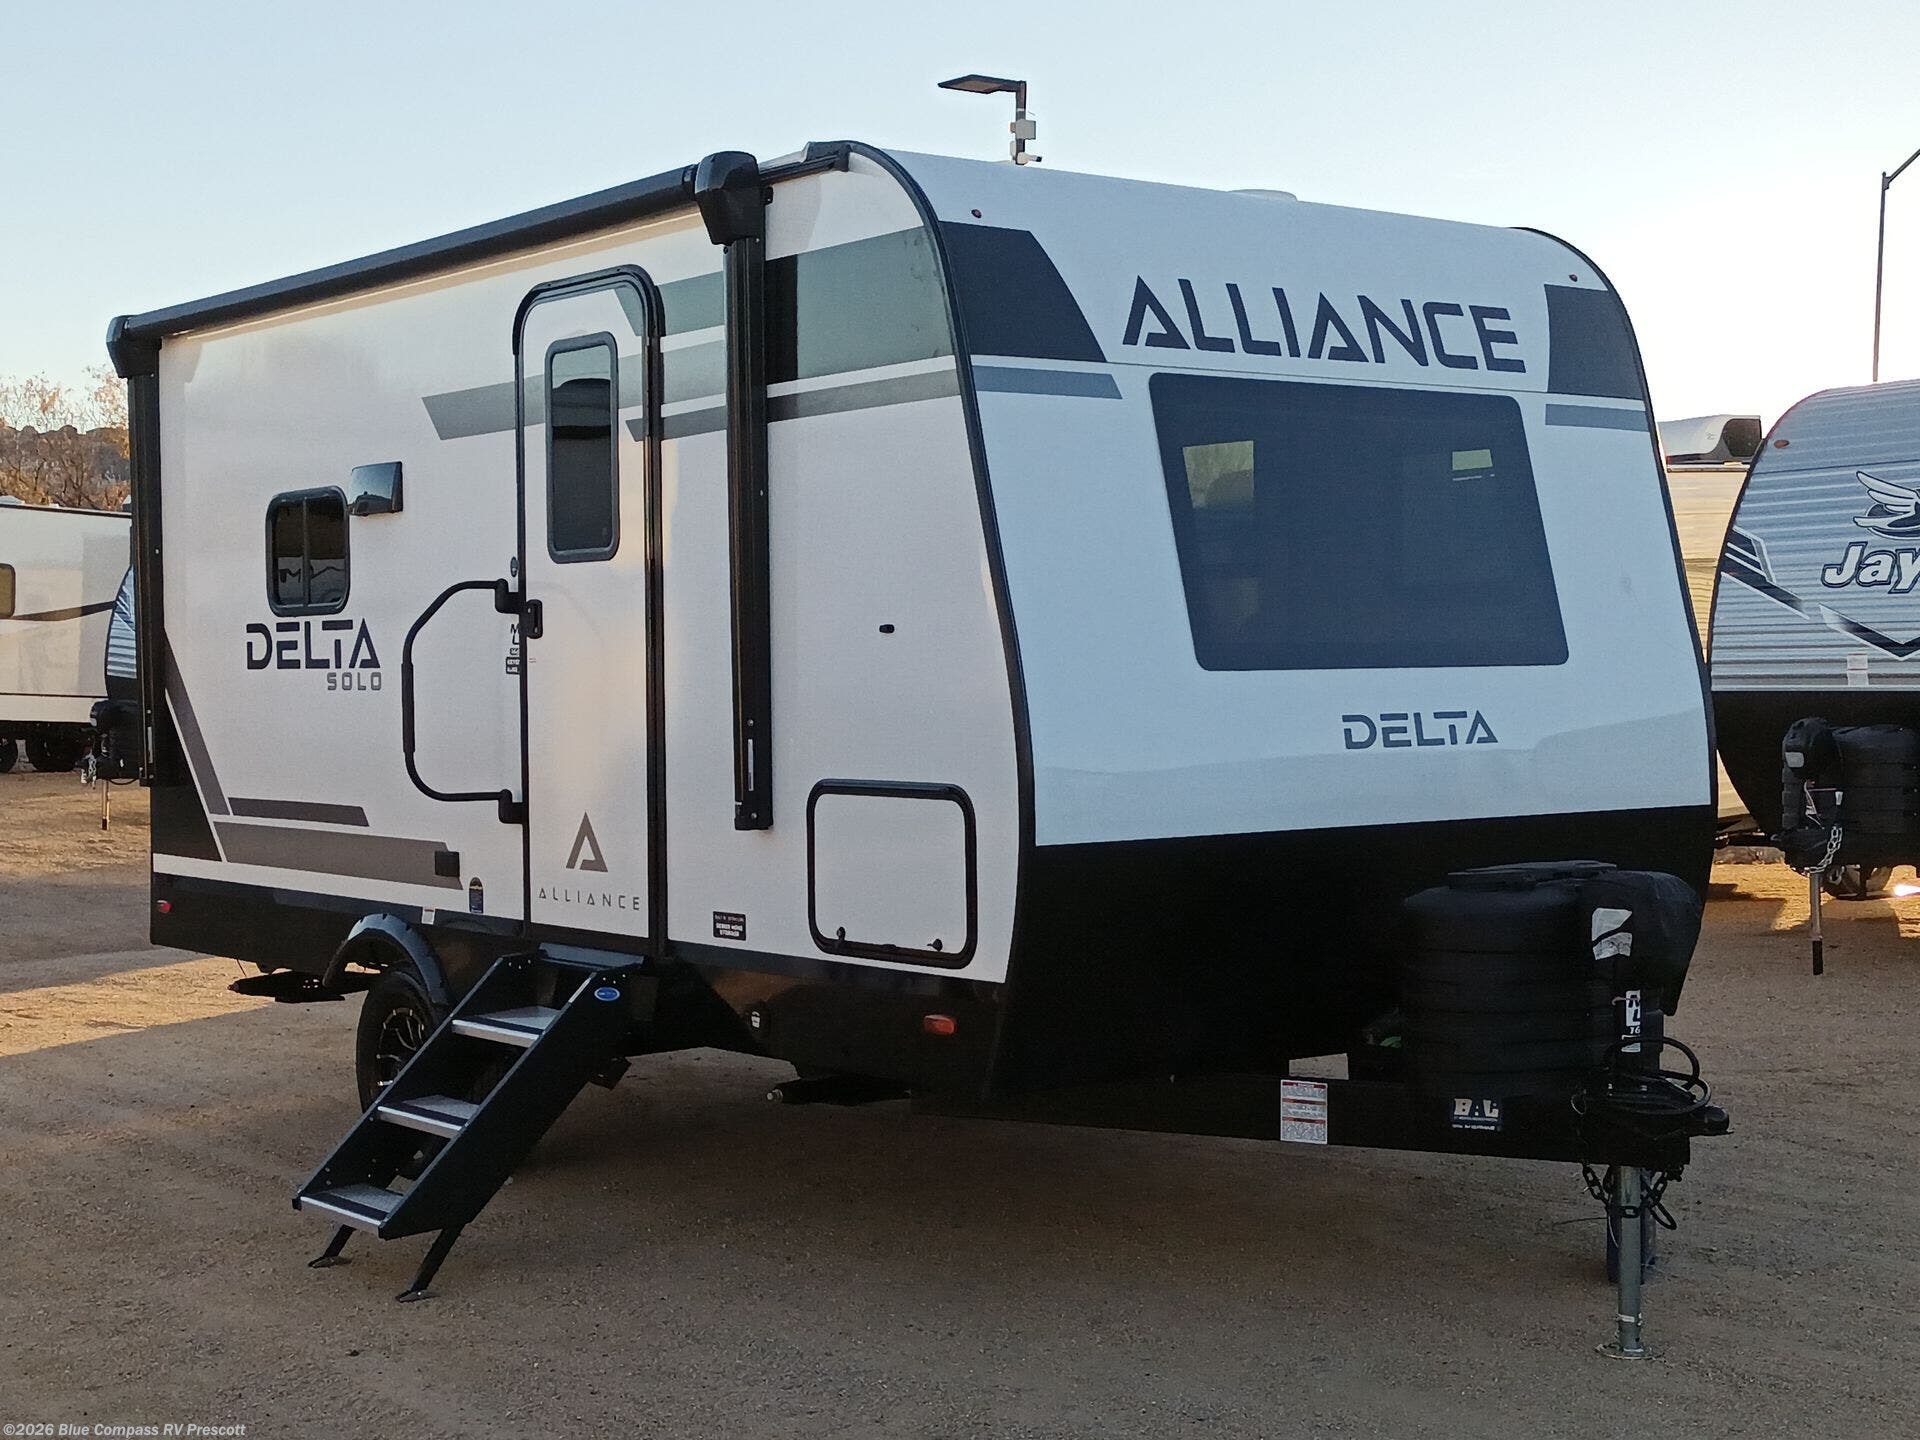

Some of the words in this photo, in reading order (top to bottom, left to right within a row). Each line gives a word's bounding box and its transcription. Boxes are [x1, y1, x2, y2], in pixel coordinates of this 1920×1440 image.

[1122, 274, 1526, 374] ALLIANCE
[246, 617, 381, 670] DELTA
[326, 671, 382, 691] SOLO
[1341, 710, 1499, 750] DELTA
[538, 886, 641, 911] ALLIANCE
